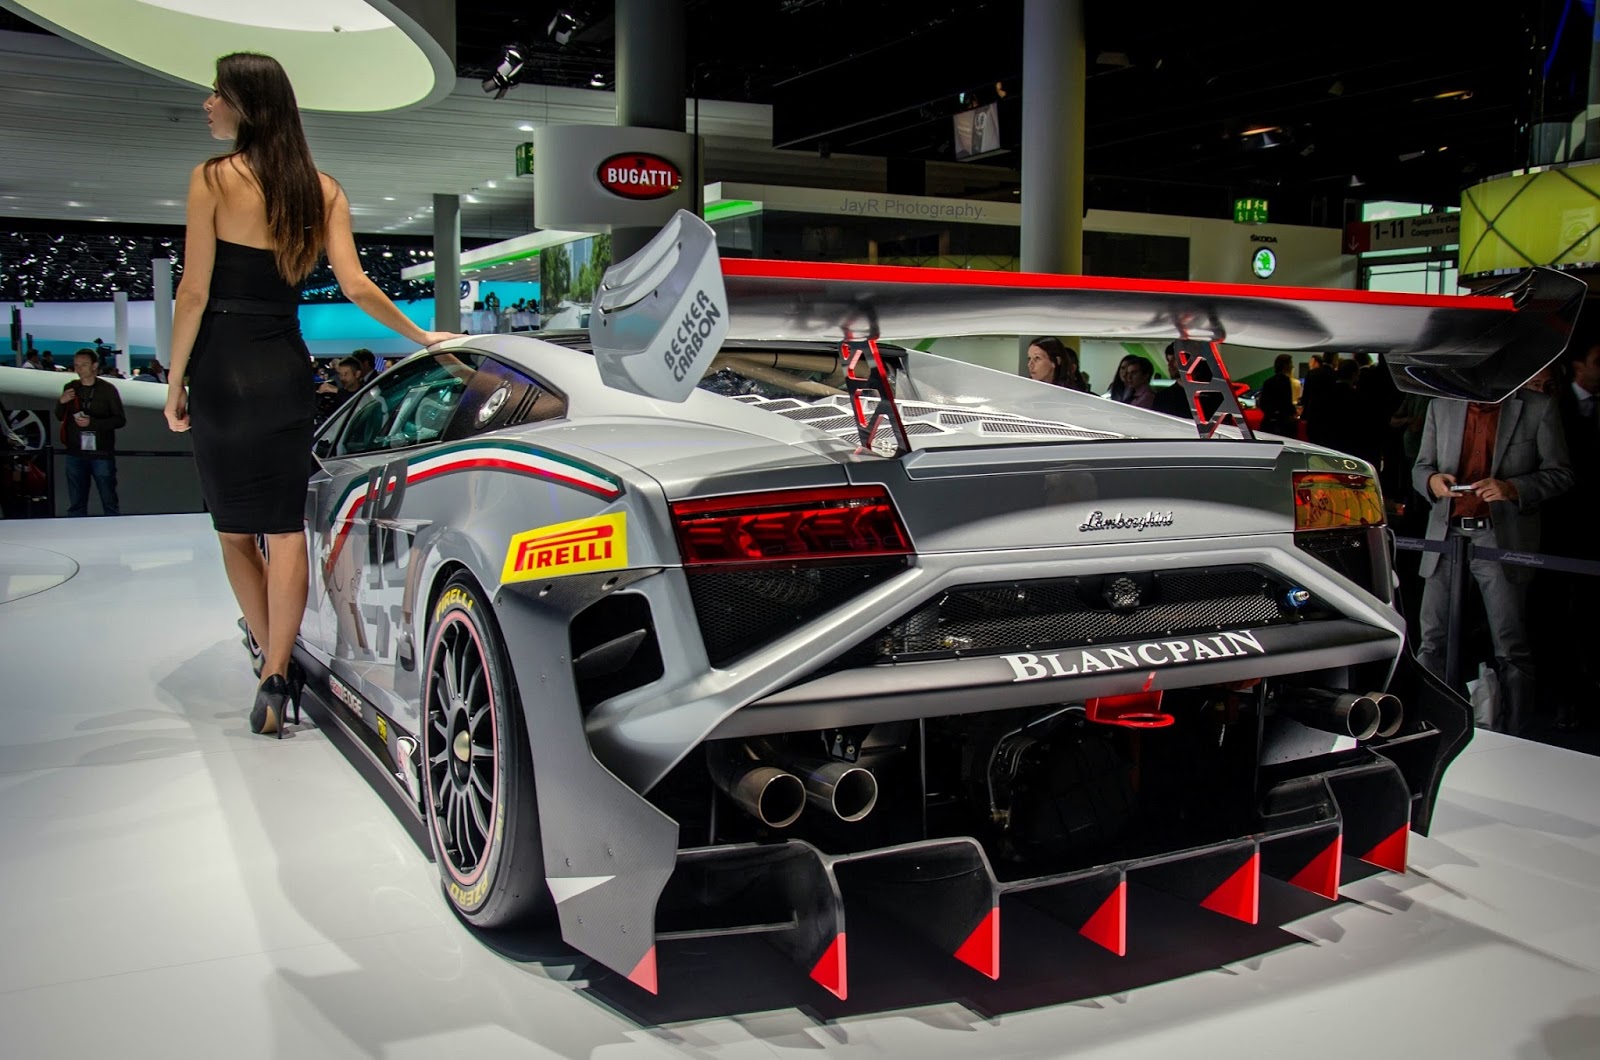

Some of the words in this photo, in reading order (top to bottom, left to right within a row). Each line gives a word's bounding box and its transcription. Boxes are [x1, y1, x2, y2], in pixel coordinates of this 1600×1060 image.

[607, 167, 672, 187] BUGATTI
[663, 289, 710, 371] BECKER
[673, 302, 721, 383] CARBON
[1078, 510, 1173, 533] Lamborghini
[513, 524, 614, 573] PIRELLI
[435, 588, 474, 623] PIRELLI
[1000, 630, 1266, 683] BLANCPAIN
